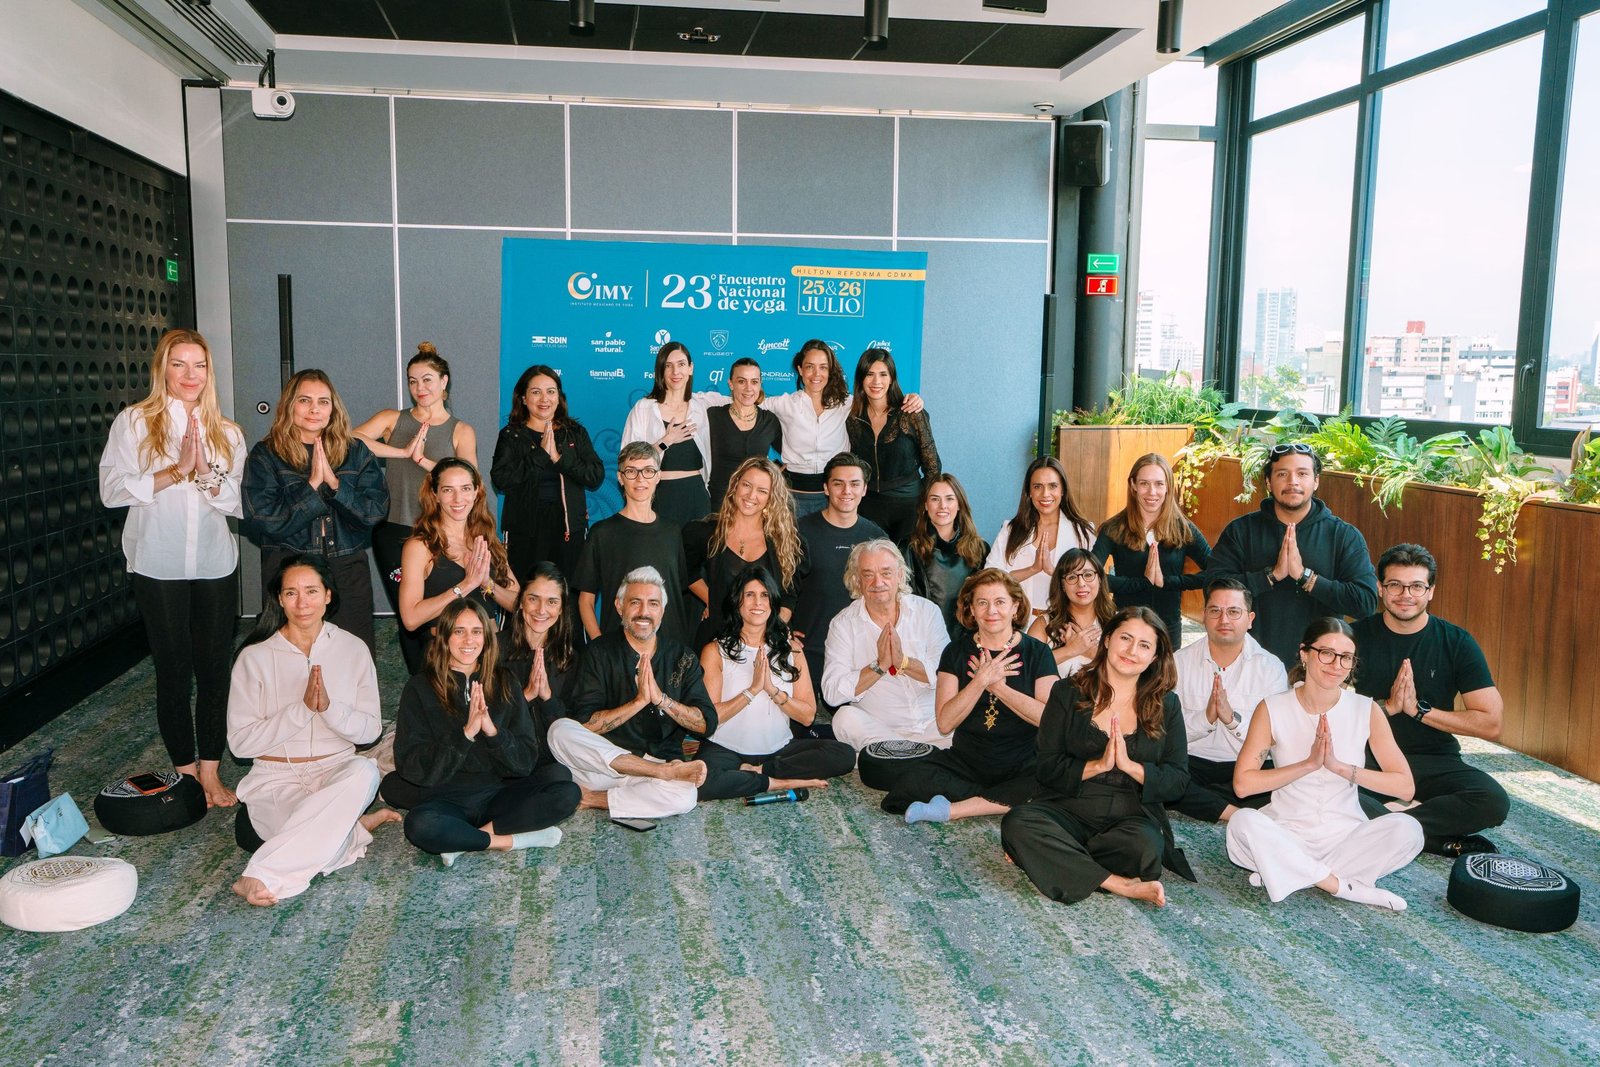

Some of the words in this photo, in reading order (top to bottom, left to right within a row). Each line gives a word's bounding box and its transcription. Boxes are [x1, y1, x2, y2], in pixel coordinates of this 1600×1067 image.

[796, 268, 832, 276] HILTON
[719, 273, 786, 286] Encuentro
[718, 286, 786, 298] Nacional
[717, 297, 740, 311] de
[743, 298, 786, 314] yoga
[801, 296, 861, 314] JULIO
[547, 336, 568, 344] ISDIN
[605, 339, 626, 347] pablo
